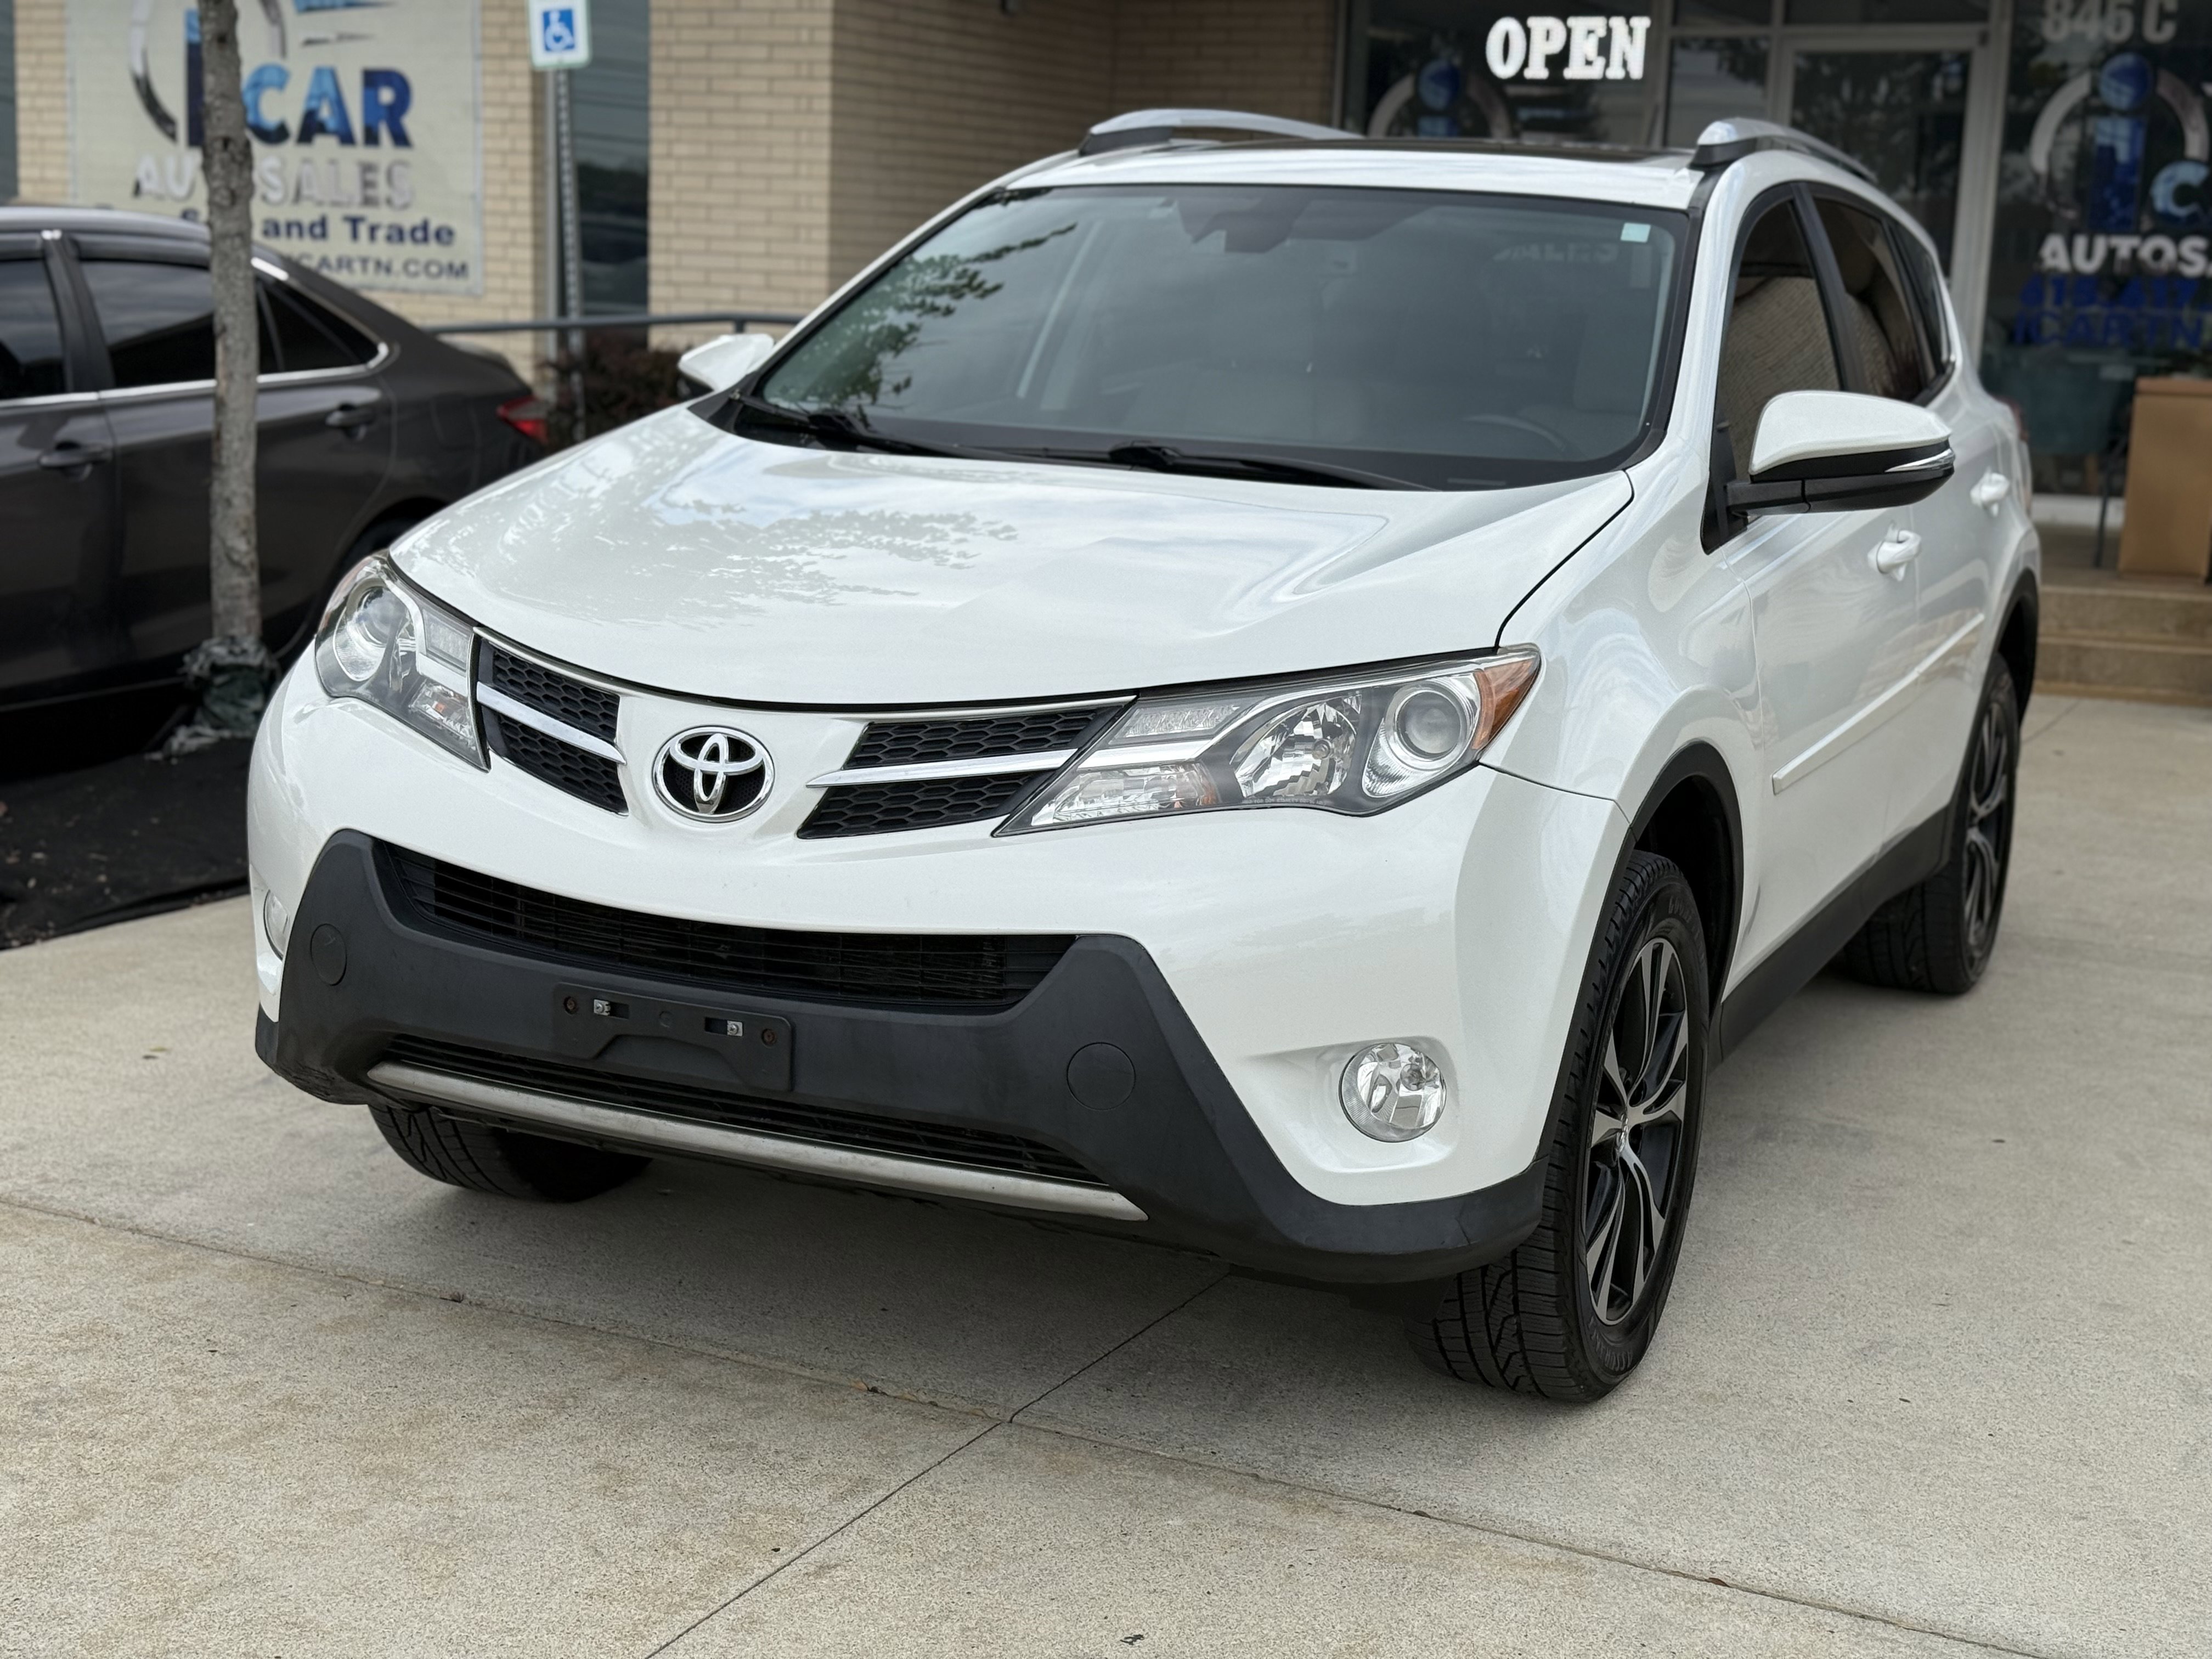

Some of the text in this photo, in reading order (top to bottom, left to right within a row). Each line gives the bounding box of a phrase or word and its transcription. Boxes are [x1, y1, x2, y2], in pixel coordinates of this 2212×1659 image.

[1486, 16, 1651, 80] OPEN
[262, 216, 455, 245] and Trade
[286, 253, 469, 279] CARTN.COM
[2040, 234, 2212, 277] AUTOS
